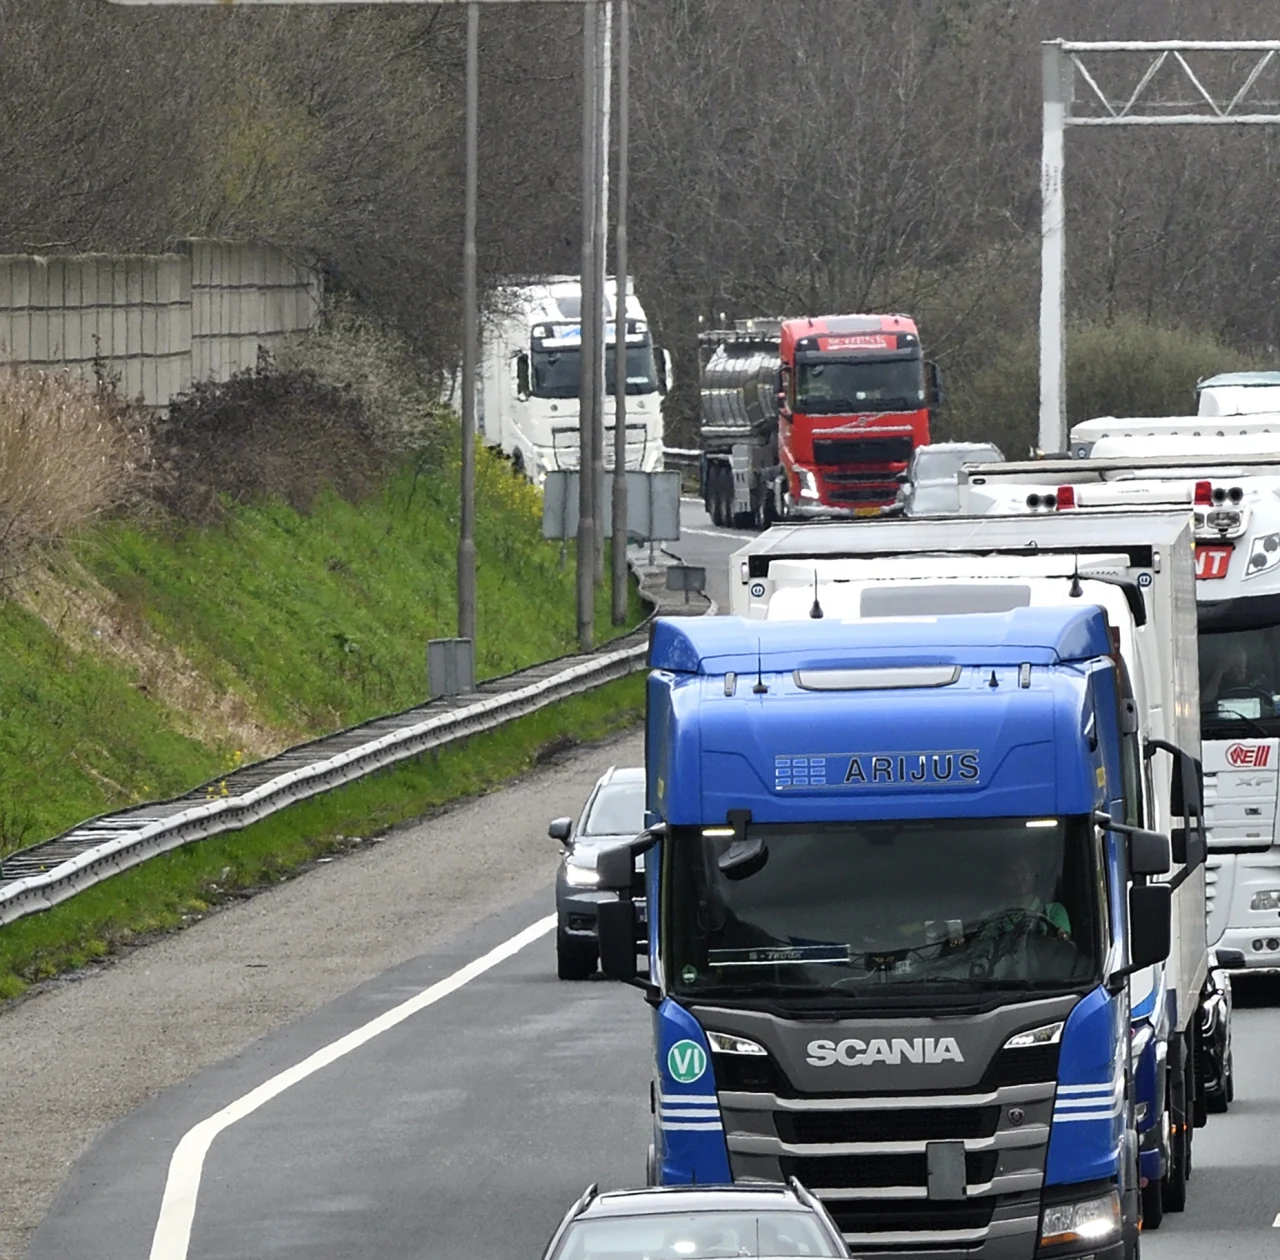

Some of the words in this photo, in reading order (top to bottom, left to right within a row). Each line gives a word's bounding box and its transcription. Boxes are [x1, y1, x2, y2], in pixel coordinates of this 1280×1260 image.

[844, 753, 980, 784] ARIJUS
[673, 1048, 701, 1075] VI
[806, 1037, 966, 1067] SCANIA
